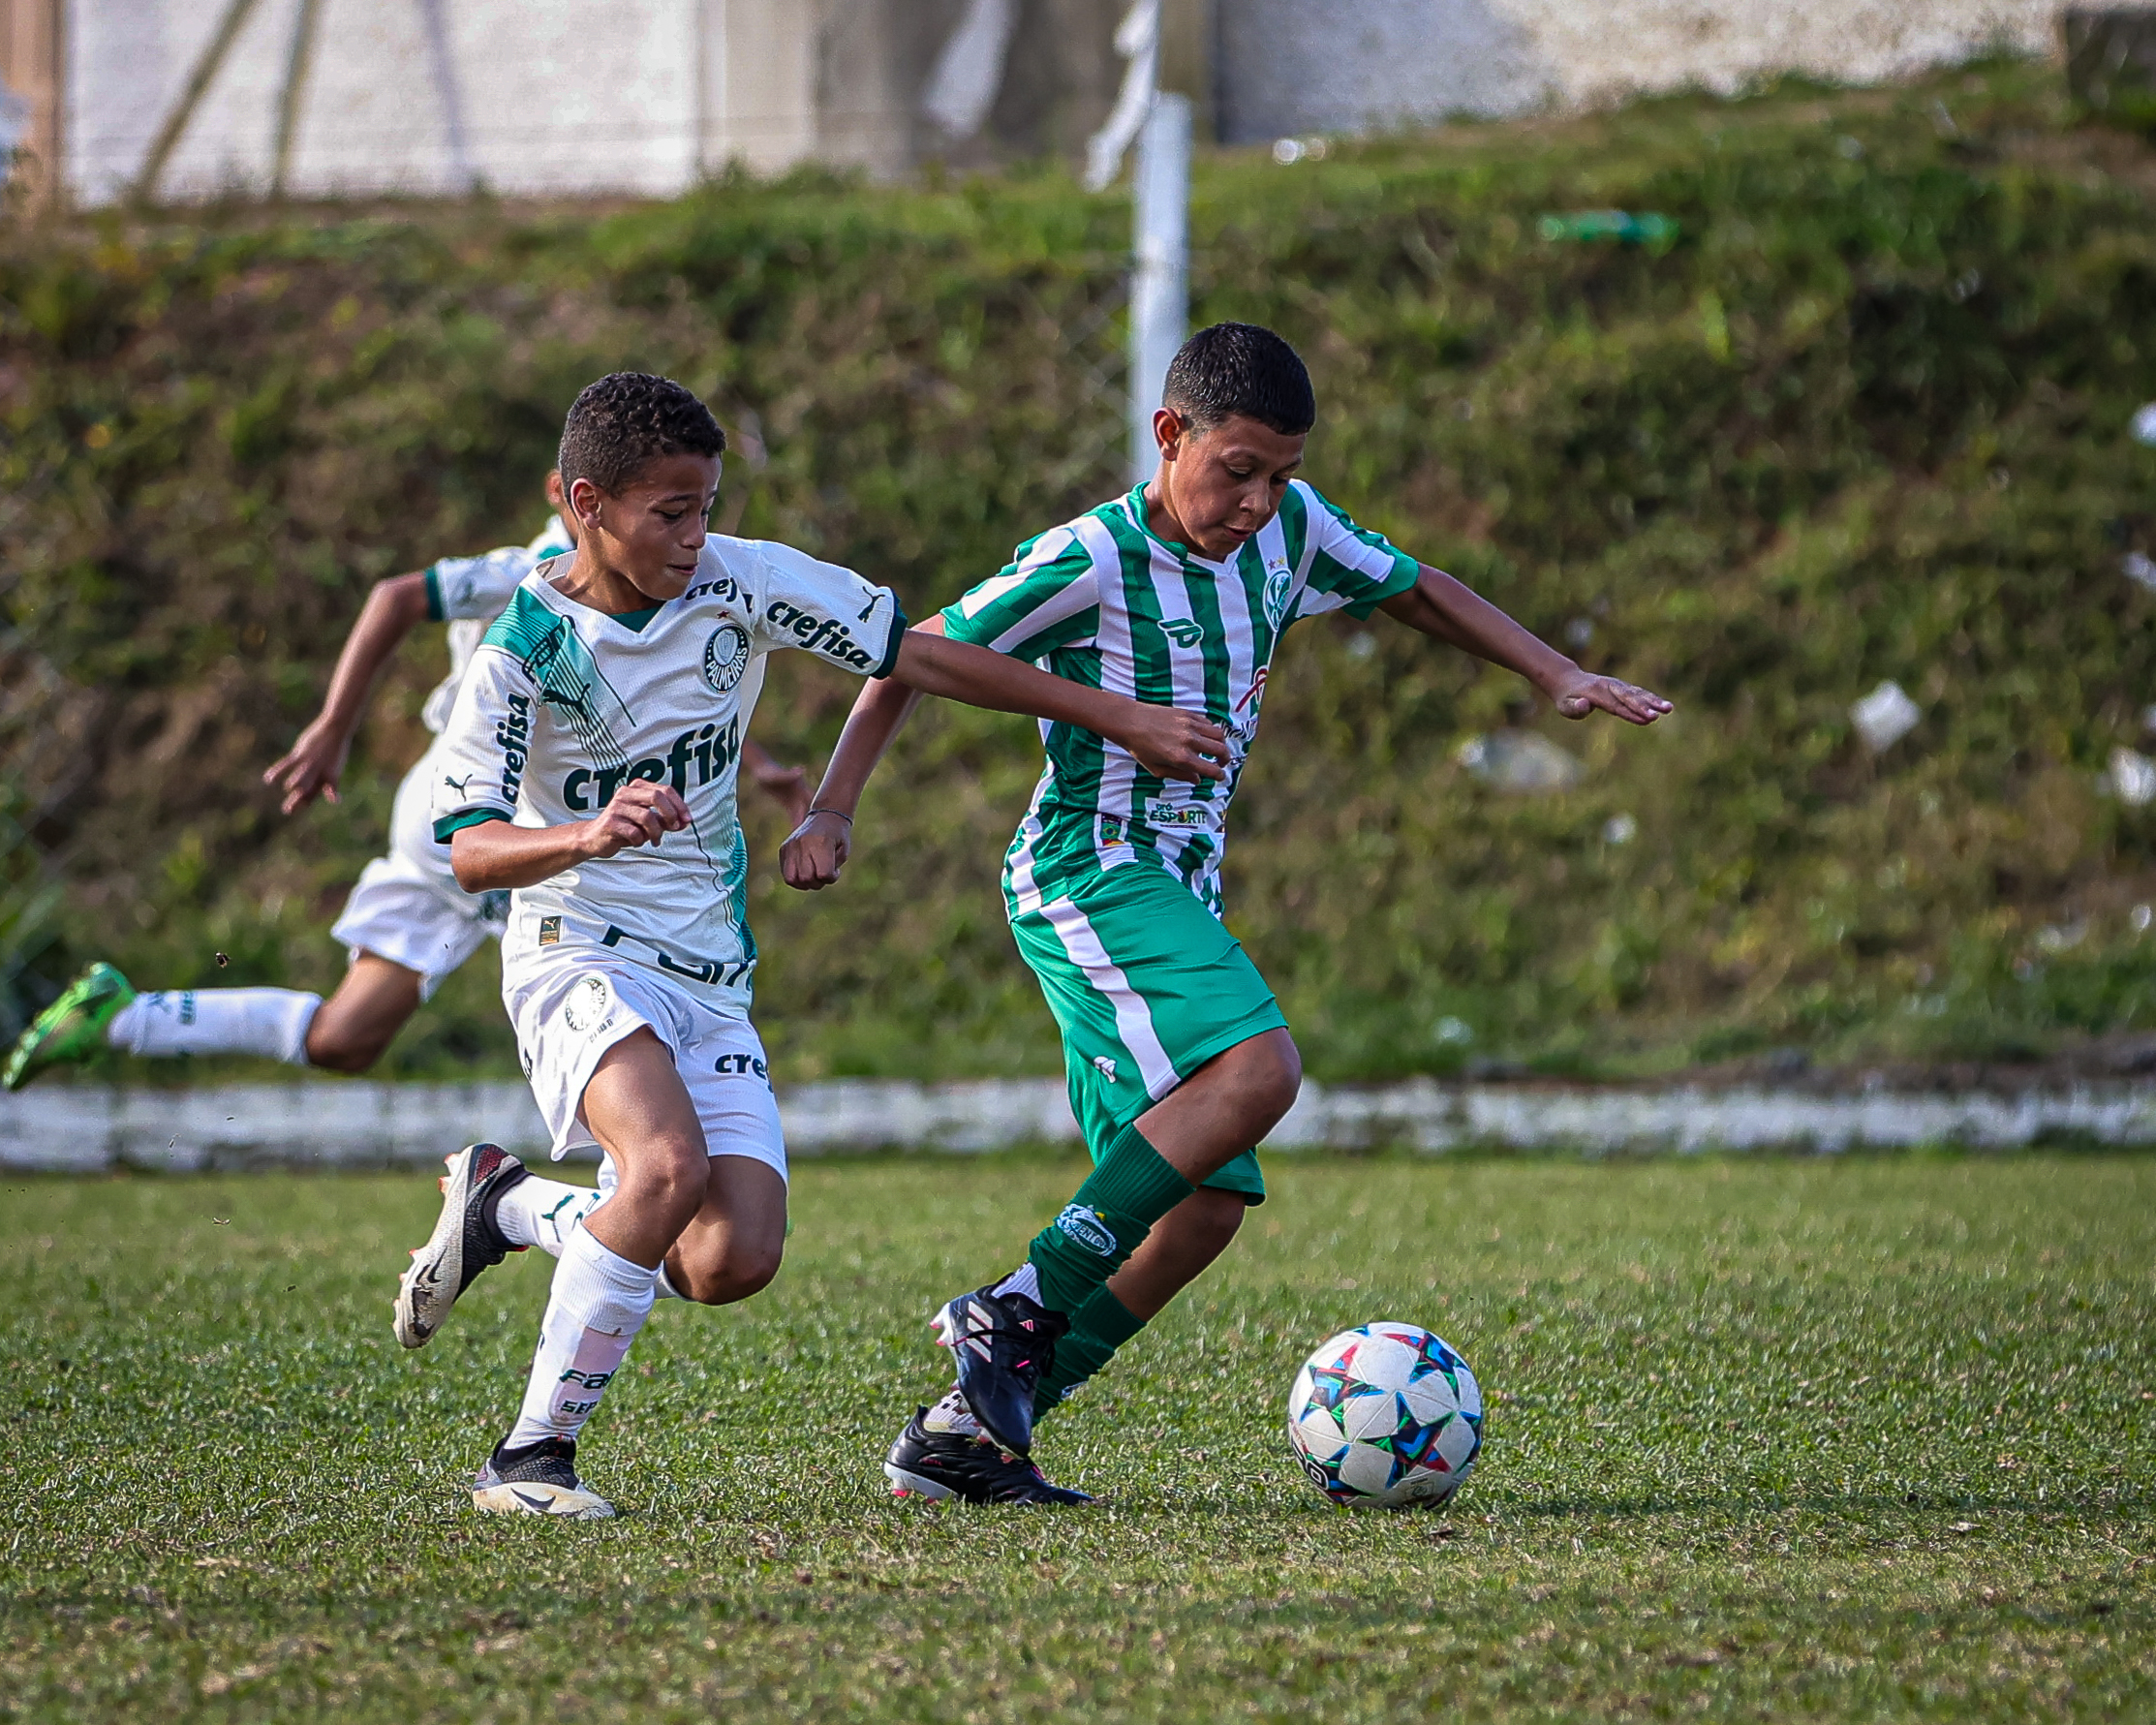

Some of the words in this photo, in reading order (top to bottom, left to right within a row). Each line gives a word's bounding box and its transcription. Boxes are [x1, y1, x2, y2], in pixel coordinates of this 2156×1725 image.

[705, 646, 748, 691] PALMEIRAS
[766, 601, 873, 669] crefisa
[496, 692, 530, 805] crefisa
